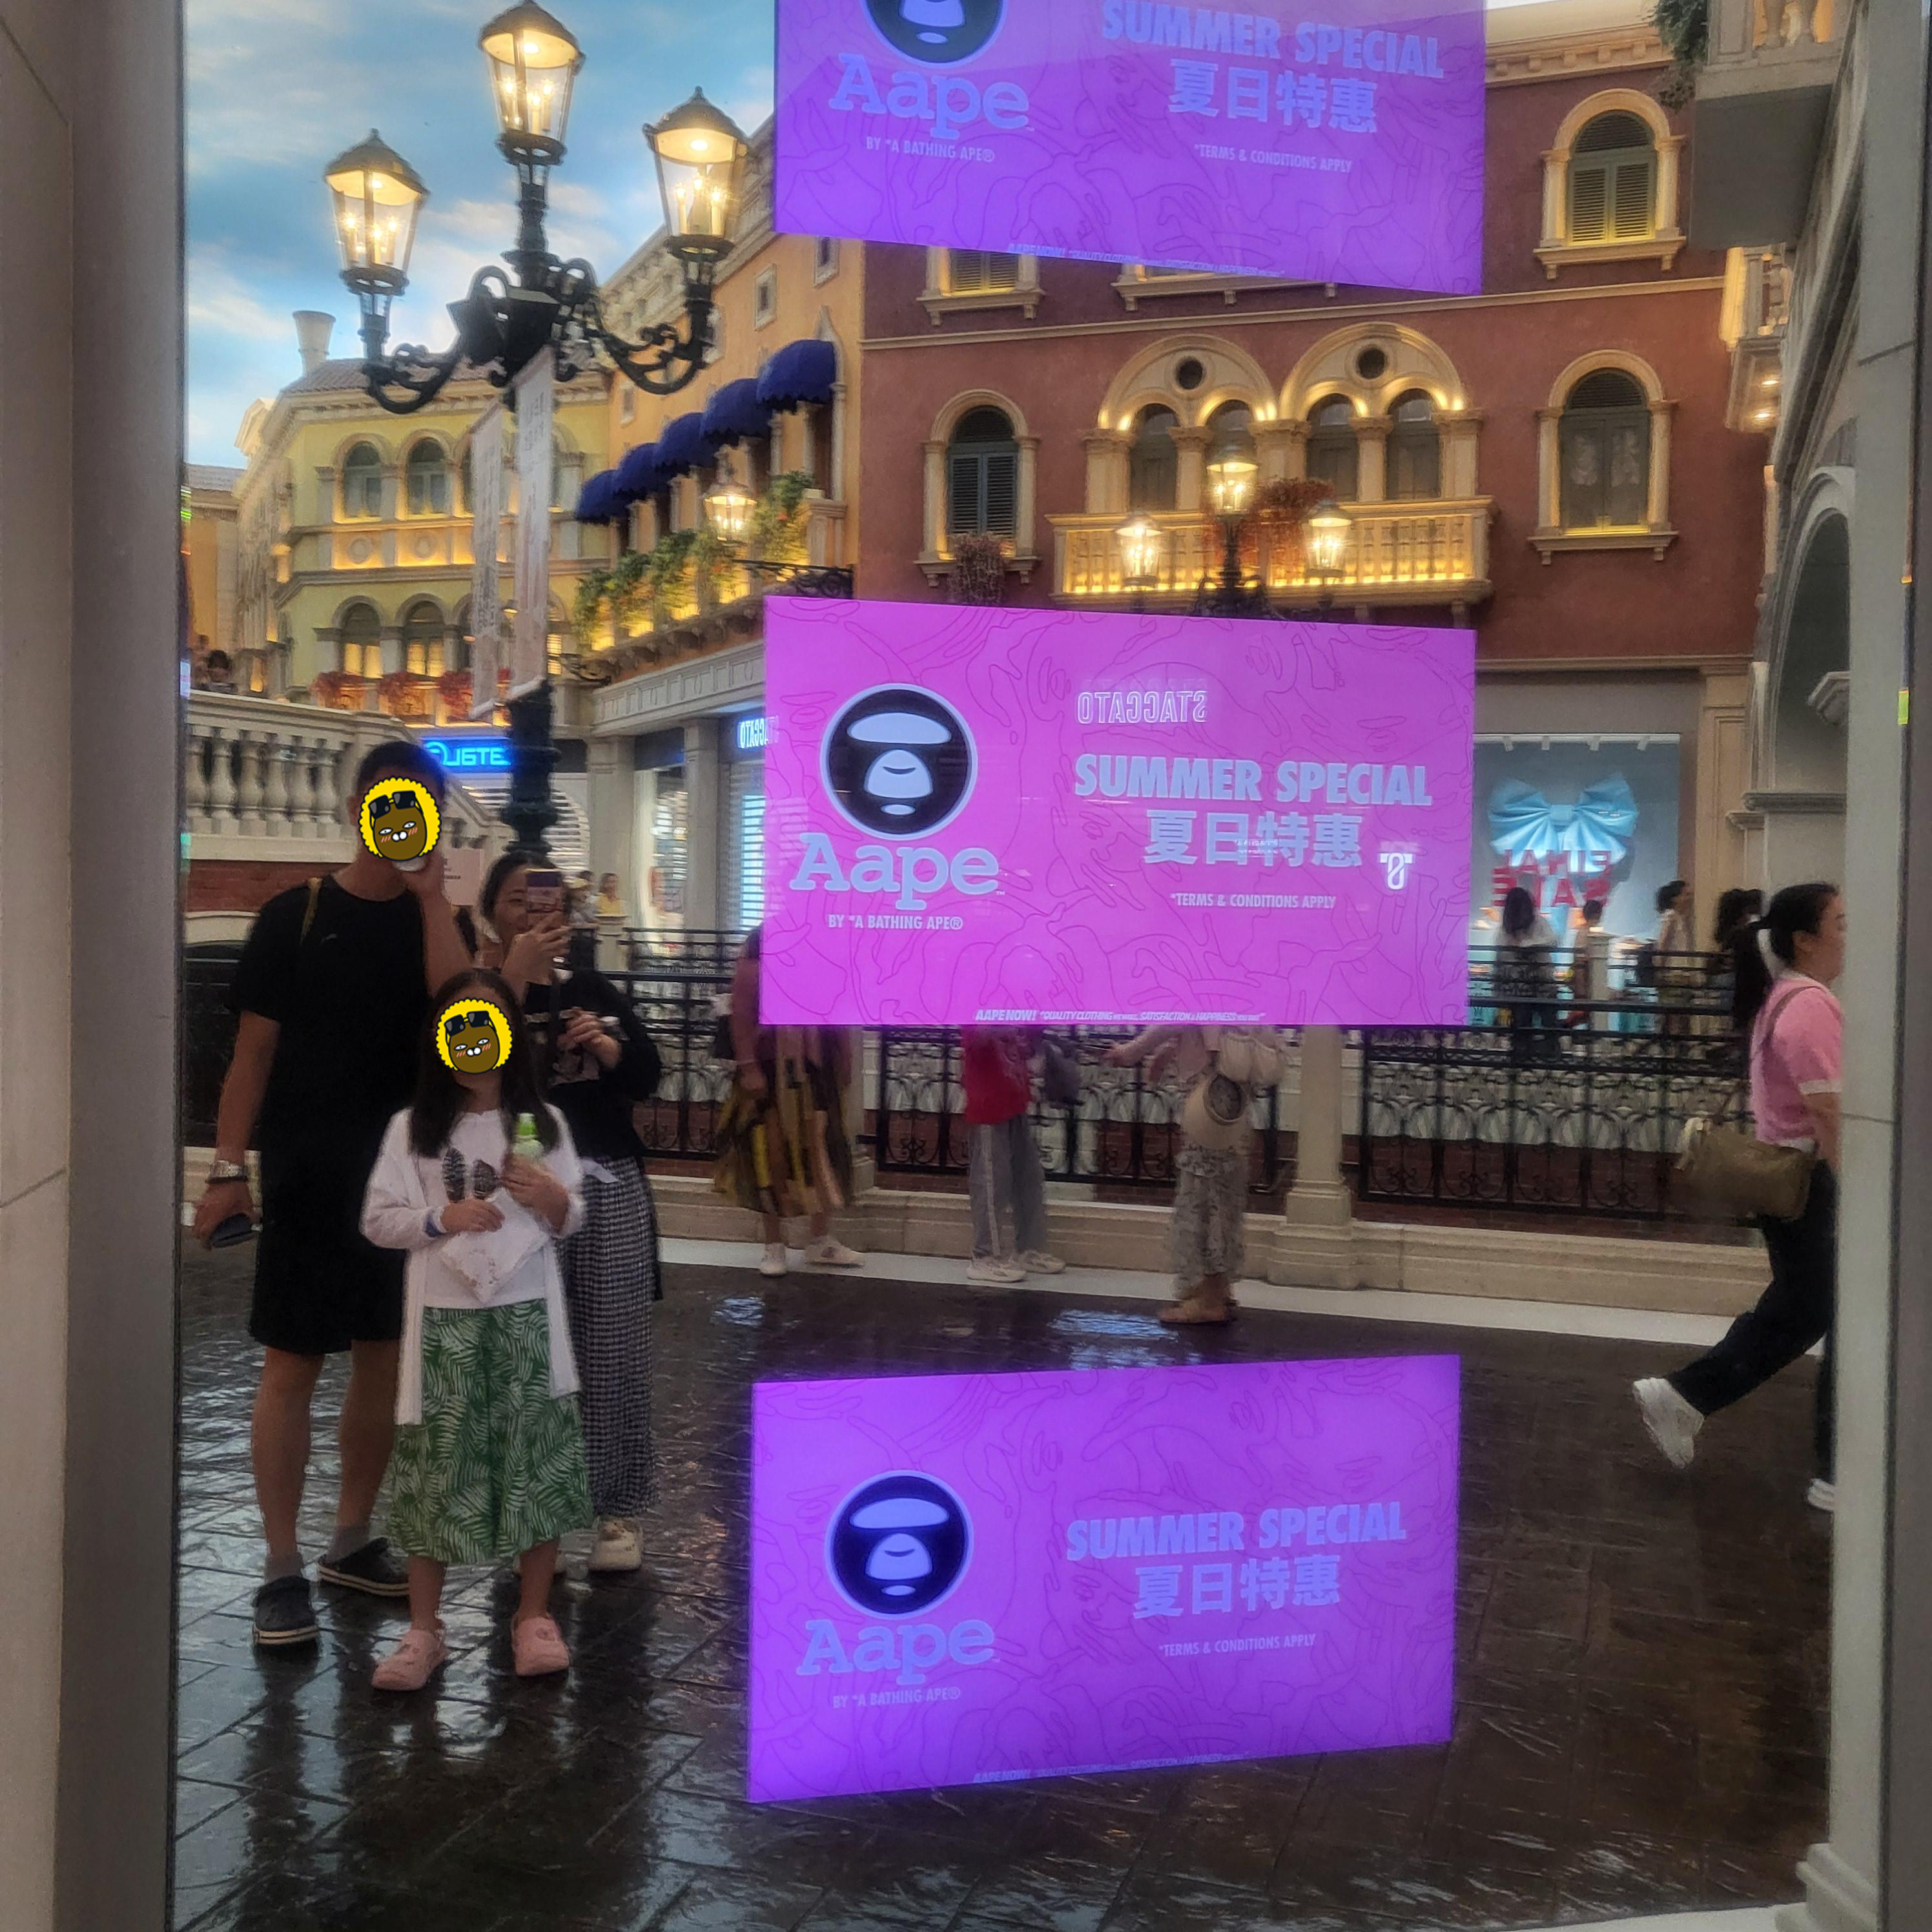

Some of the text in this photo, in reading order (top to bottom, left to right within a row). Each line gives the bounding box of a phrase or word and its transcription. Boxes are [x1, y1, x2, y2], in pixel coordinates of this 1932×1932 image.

[1102, 1, 1444, 78] SUMMER SPECIAL
[828, 53, 1029, 139] Aape
[1169, 58, 1377, 134] 夏日特惠
[866, 136, 881, 150] BY
[903, 140, 956, 159] BATHING
[1238, 149, 1247, 161] &
[1250, 150, 1316, 169] CONDITIONS
[1319, 159, 1352, 173] APPLY
[1074, 754, 1433, 807] SUMMER SPECIAL
[1143, 809, 1362, 867] 夏日特惠
[789, 832, 1000, 910] Aape
[828, 914, 845, 928] BY
[868, 915, 923, 929] BATHING
[1217, 894, 1226, 907] &
[1229, 894, 1299, 908] CONDITIONS
[1302, 896, 1336, 909] APPLY
[1066, 1501, 1406, 1561] SUMMER SPECIAL
[1133, 1554, 1341, 1619] 夏日特惠
[796, 1619, 994, 1685] Aape
[1202, 1641, 1211, 1654] &
[1214, 1636, 1280, 1653] CONDITIONS
[1284, 1634, 1315, 1647] APPLY
[833, 1695, 848, 1709] BY
[870, 1689, 921, 1705] BATHING
